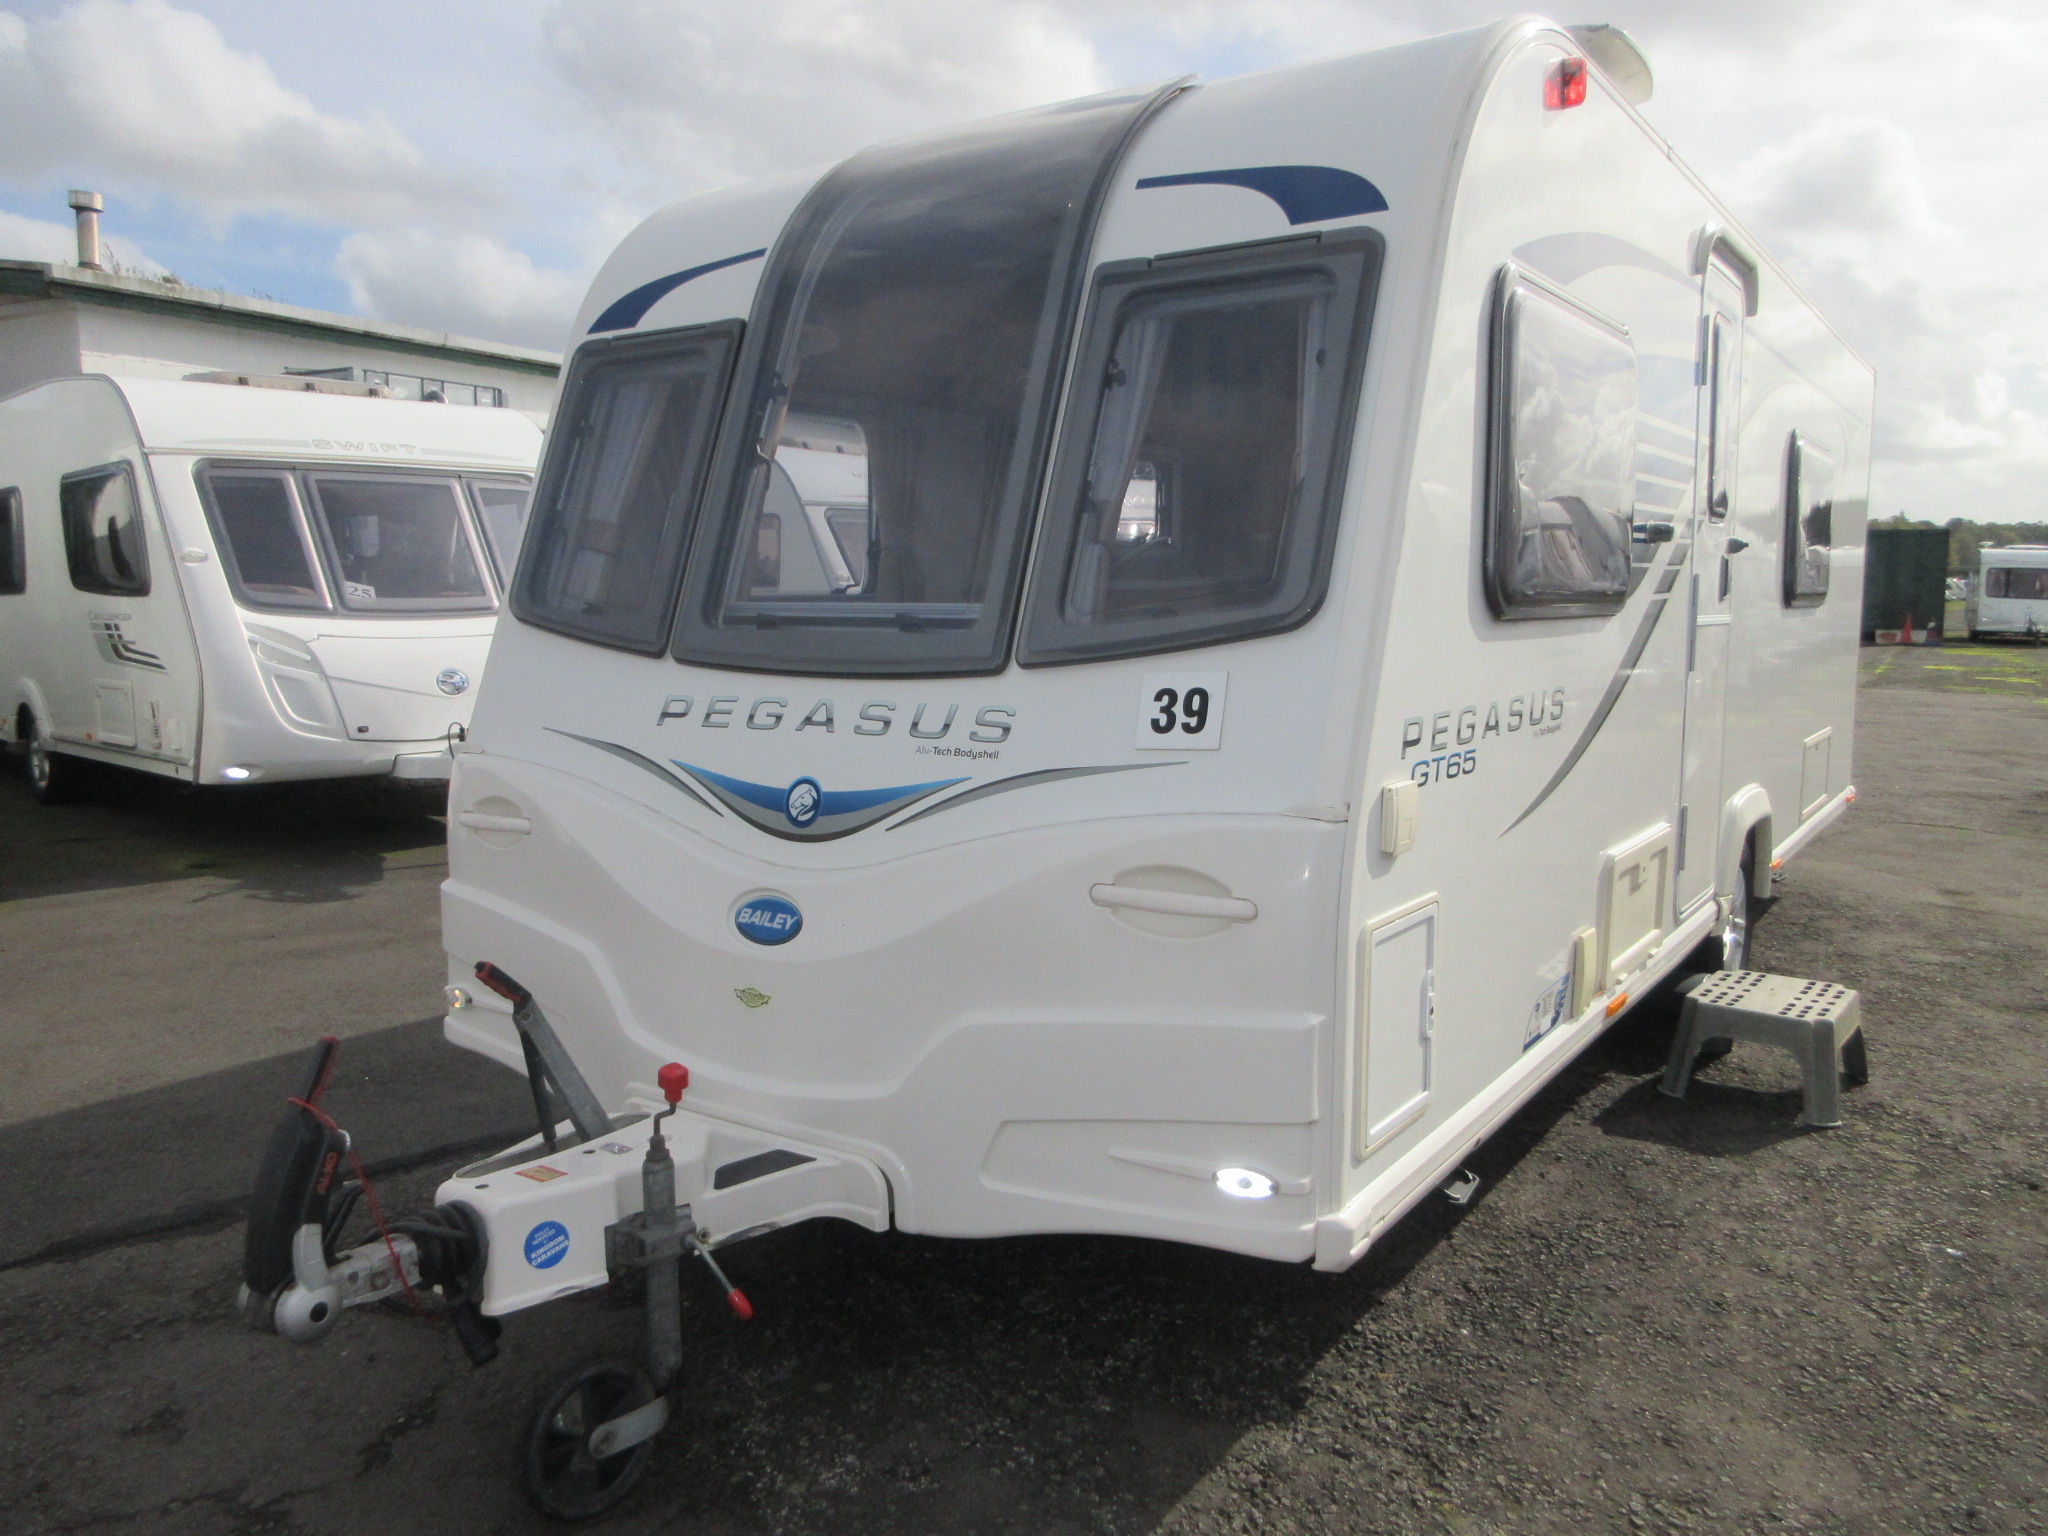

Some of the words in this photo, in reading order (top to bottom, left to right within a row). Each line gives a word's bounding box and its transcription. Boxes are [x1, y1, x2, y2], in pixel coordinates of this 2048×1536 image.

[311, 438, 417, 455] SWIFT
[348, 585, 372, 599] 25
[656, 694, 1017, 743] PEGASUS
[1150, 687, 1209, 734] 39
[1401, 686, 1565, 760] PEGASUS
[914, 745, 952, 756] Alu-Tech
[953, 748, 1000, 760] Bodyshell
[1411, 748, 1477, 787] GT65
[737, 907, 799, 930] BAILEY
[531, 1234, 565, 1259] KINGDOM
[532, 1239, 569, 1266] CARAVANS
